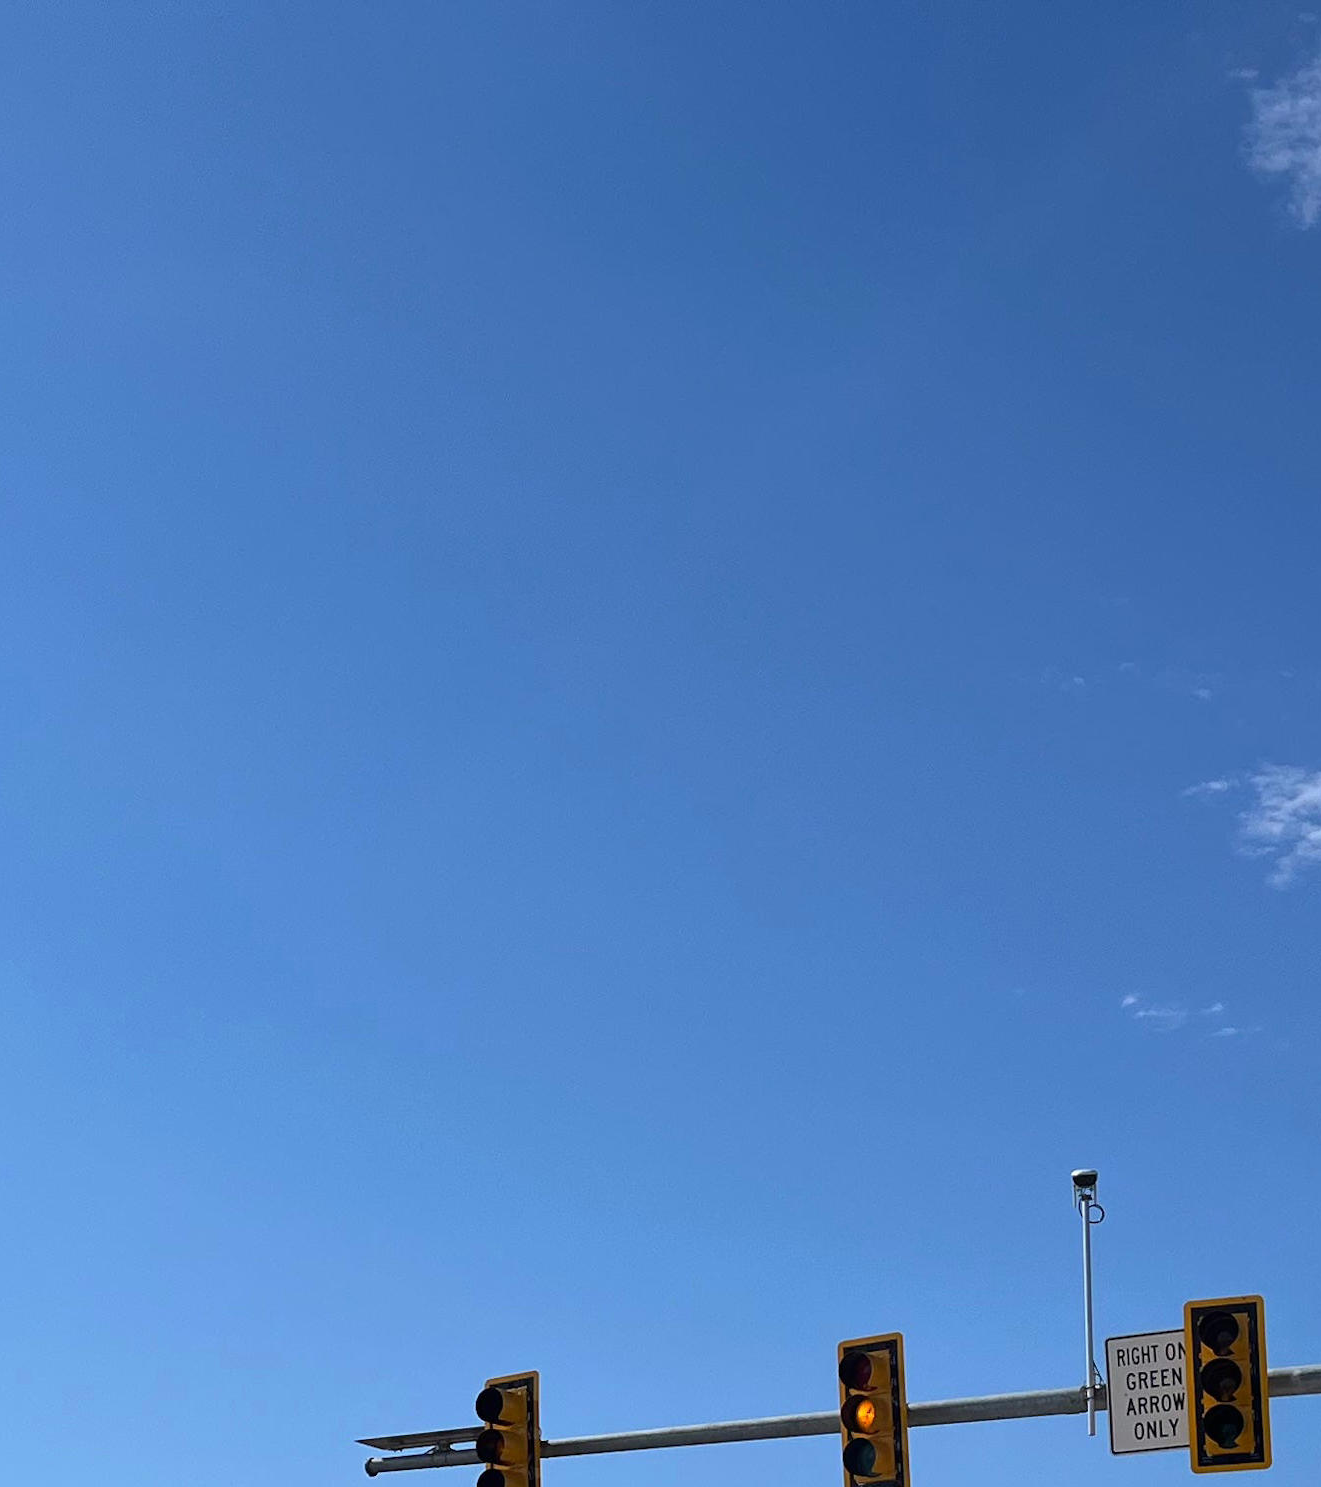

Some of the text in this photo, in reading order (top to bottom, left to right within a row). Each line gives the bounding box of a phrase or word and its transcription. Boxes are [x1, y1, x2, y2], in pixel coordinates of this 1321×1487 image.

[1117, 1345, 1158, 1367] RIGHT
[1126, 1368, 1182, 1391] GREEN
[1126, 1393, 1185, 1416] ARROW
[1134, 1419, 1179, 1440] ONLY
